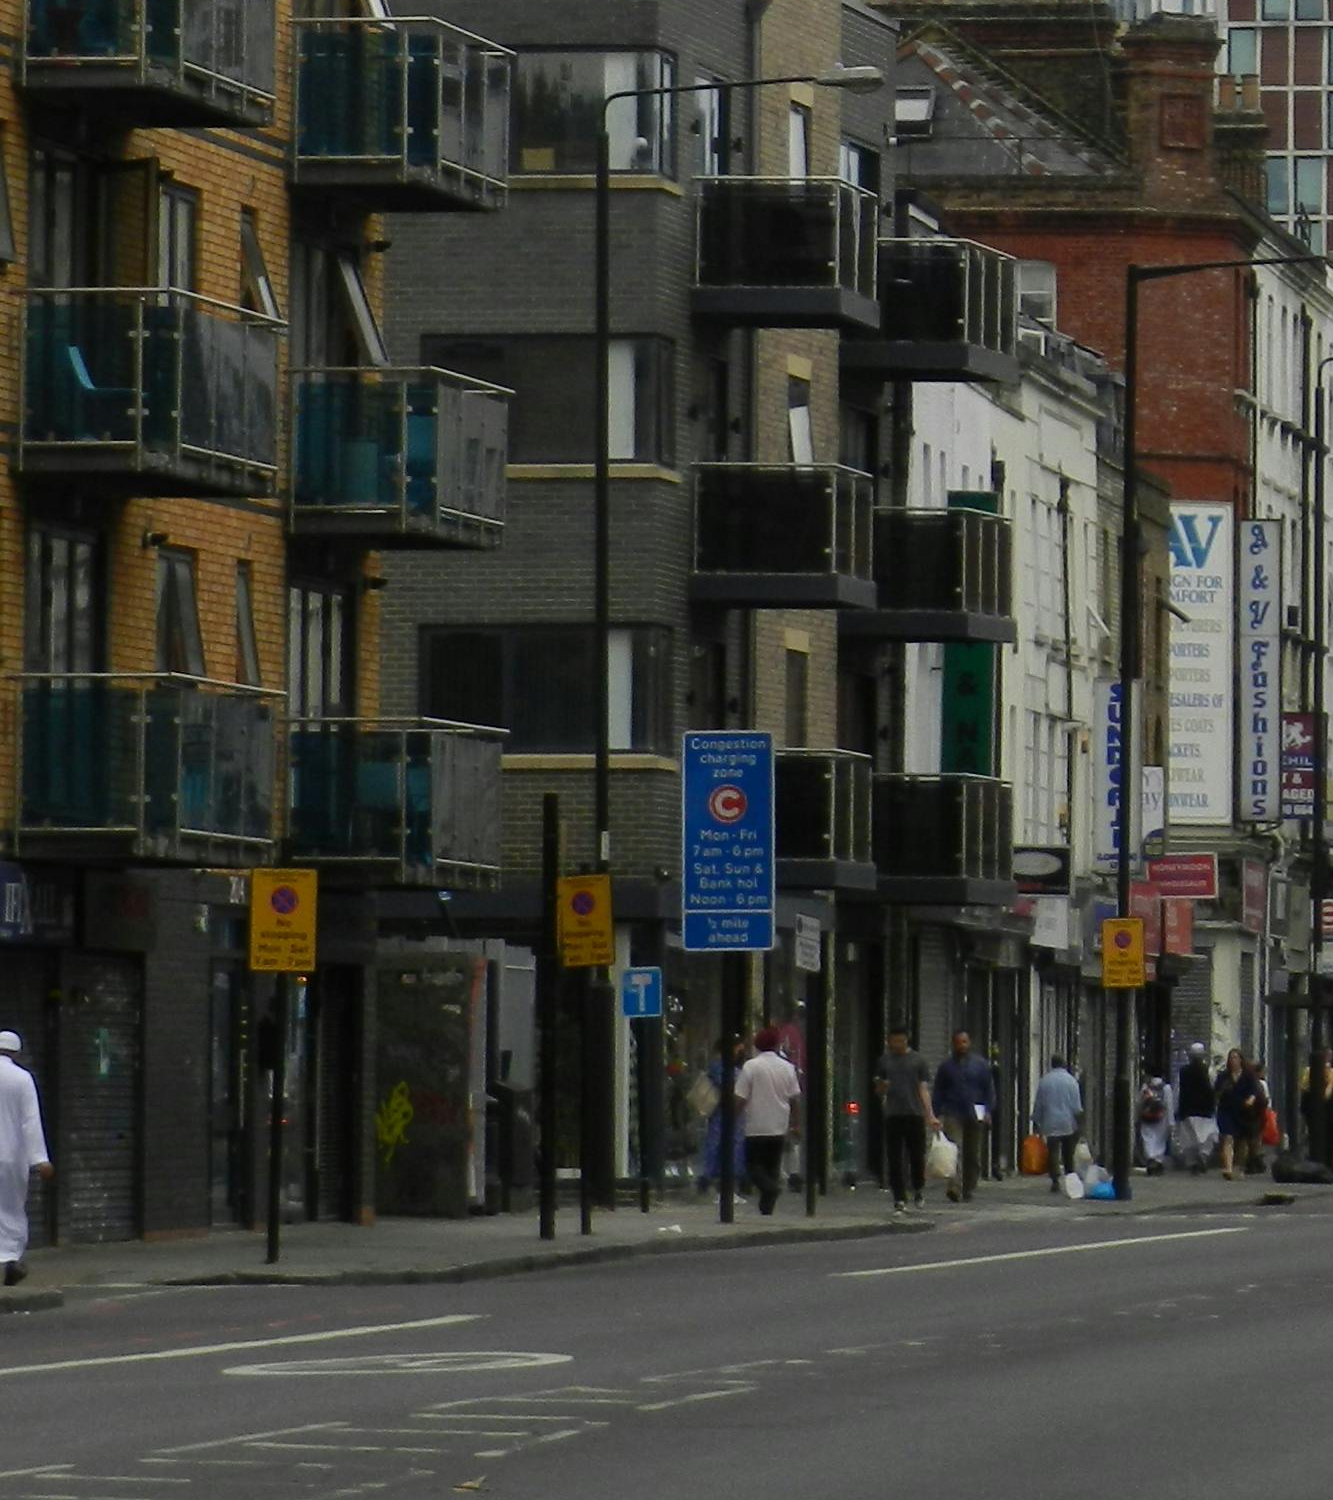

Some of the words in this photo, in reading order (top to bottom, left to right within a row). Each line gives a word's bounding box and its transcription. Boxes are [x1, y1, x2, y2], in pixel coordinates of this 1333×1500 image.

[1197, 575, 1223, 589] FOR
[1251, 564, 1269, 590] &
[1250, 640, 1270, 815] Fashions
[690, 738, 767, 752] Congestion
[700, 752, 757, 767] charging
[713, 768, 744, 778] zone
[700, 829, 729, 841] Mon
[740, 829, 758, 841] Fri
[725, 863, 750, 875] Sun
[700, 877, 732, 889] Bank
[737, 877, 758, 889] hol
[690, 893, 727, 905] Noon
[708, 932, 749, 944] ahead
